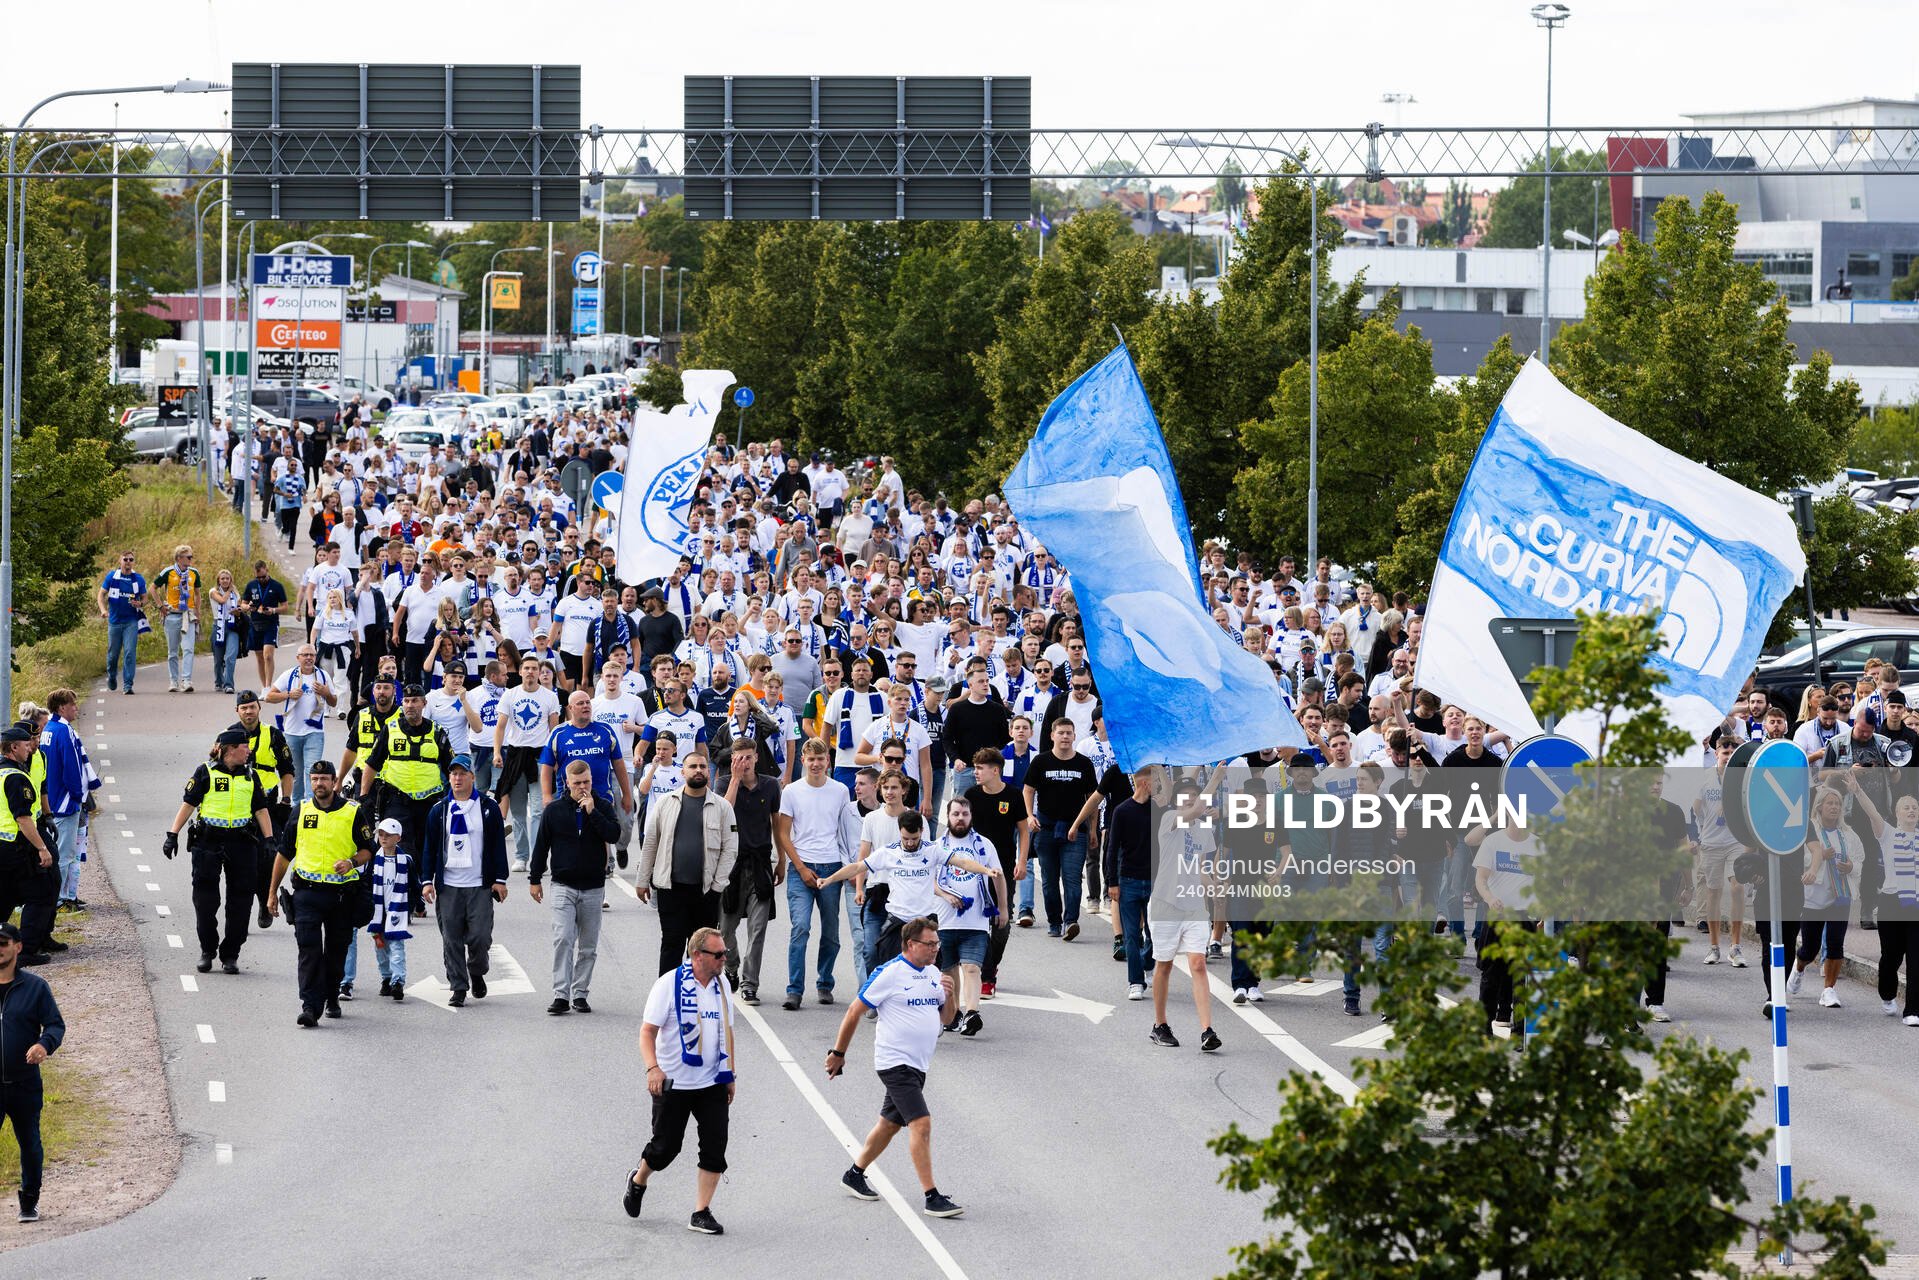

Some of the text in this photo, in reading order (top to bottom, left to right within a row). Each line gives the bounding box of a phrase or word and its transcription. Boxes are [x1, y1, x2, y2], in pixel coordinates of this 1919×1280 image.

[1611, 501, 1696, 569] THE
[1462, 512, 1646, 617] NORDAH
[1528, 513, 1668, 608] CURVA
[1034, 712, 1044, 722] 18
[927, 721, 945, 733] ANT
[567, 746, 604, 757] HOLMEN
[894, 869, 930, 877] HOLMEN
[682, 987, 698, 1013] IFK
[907, 998, 939, 1006] HOLMEN
